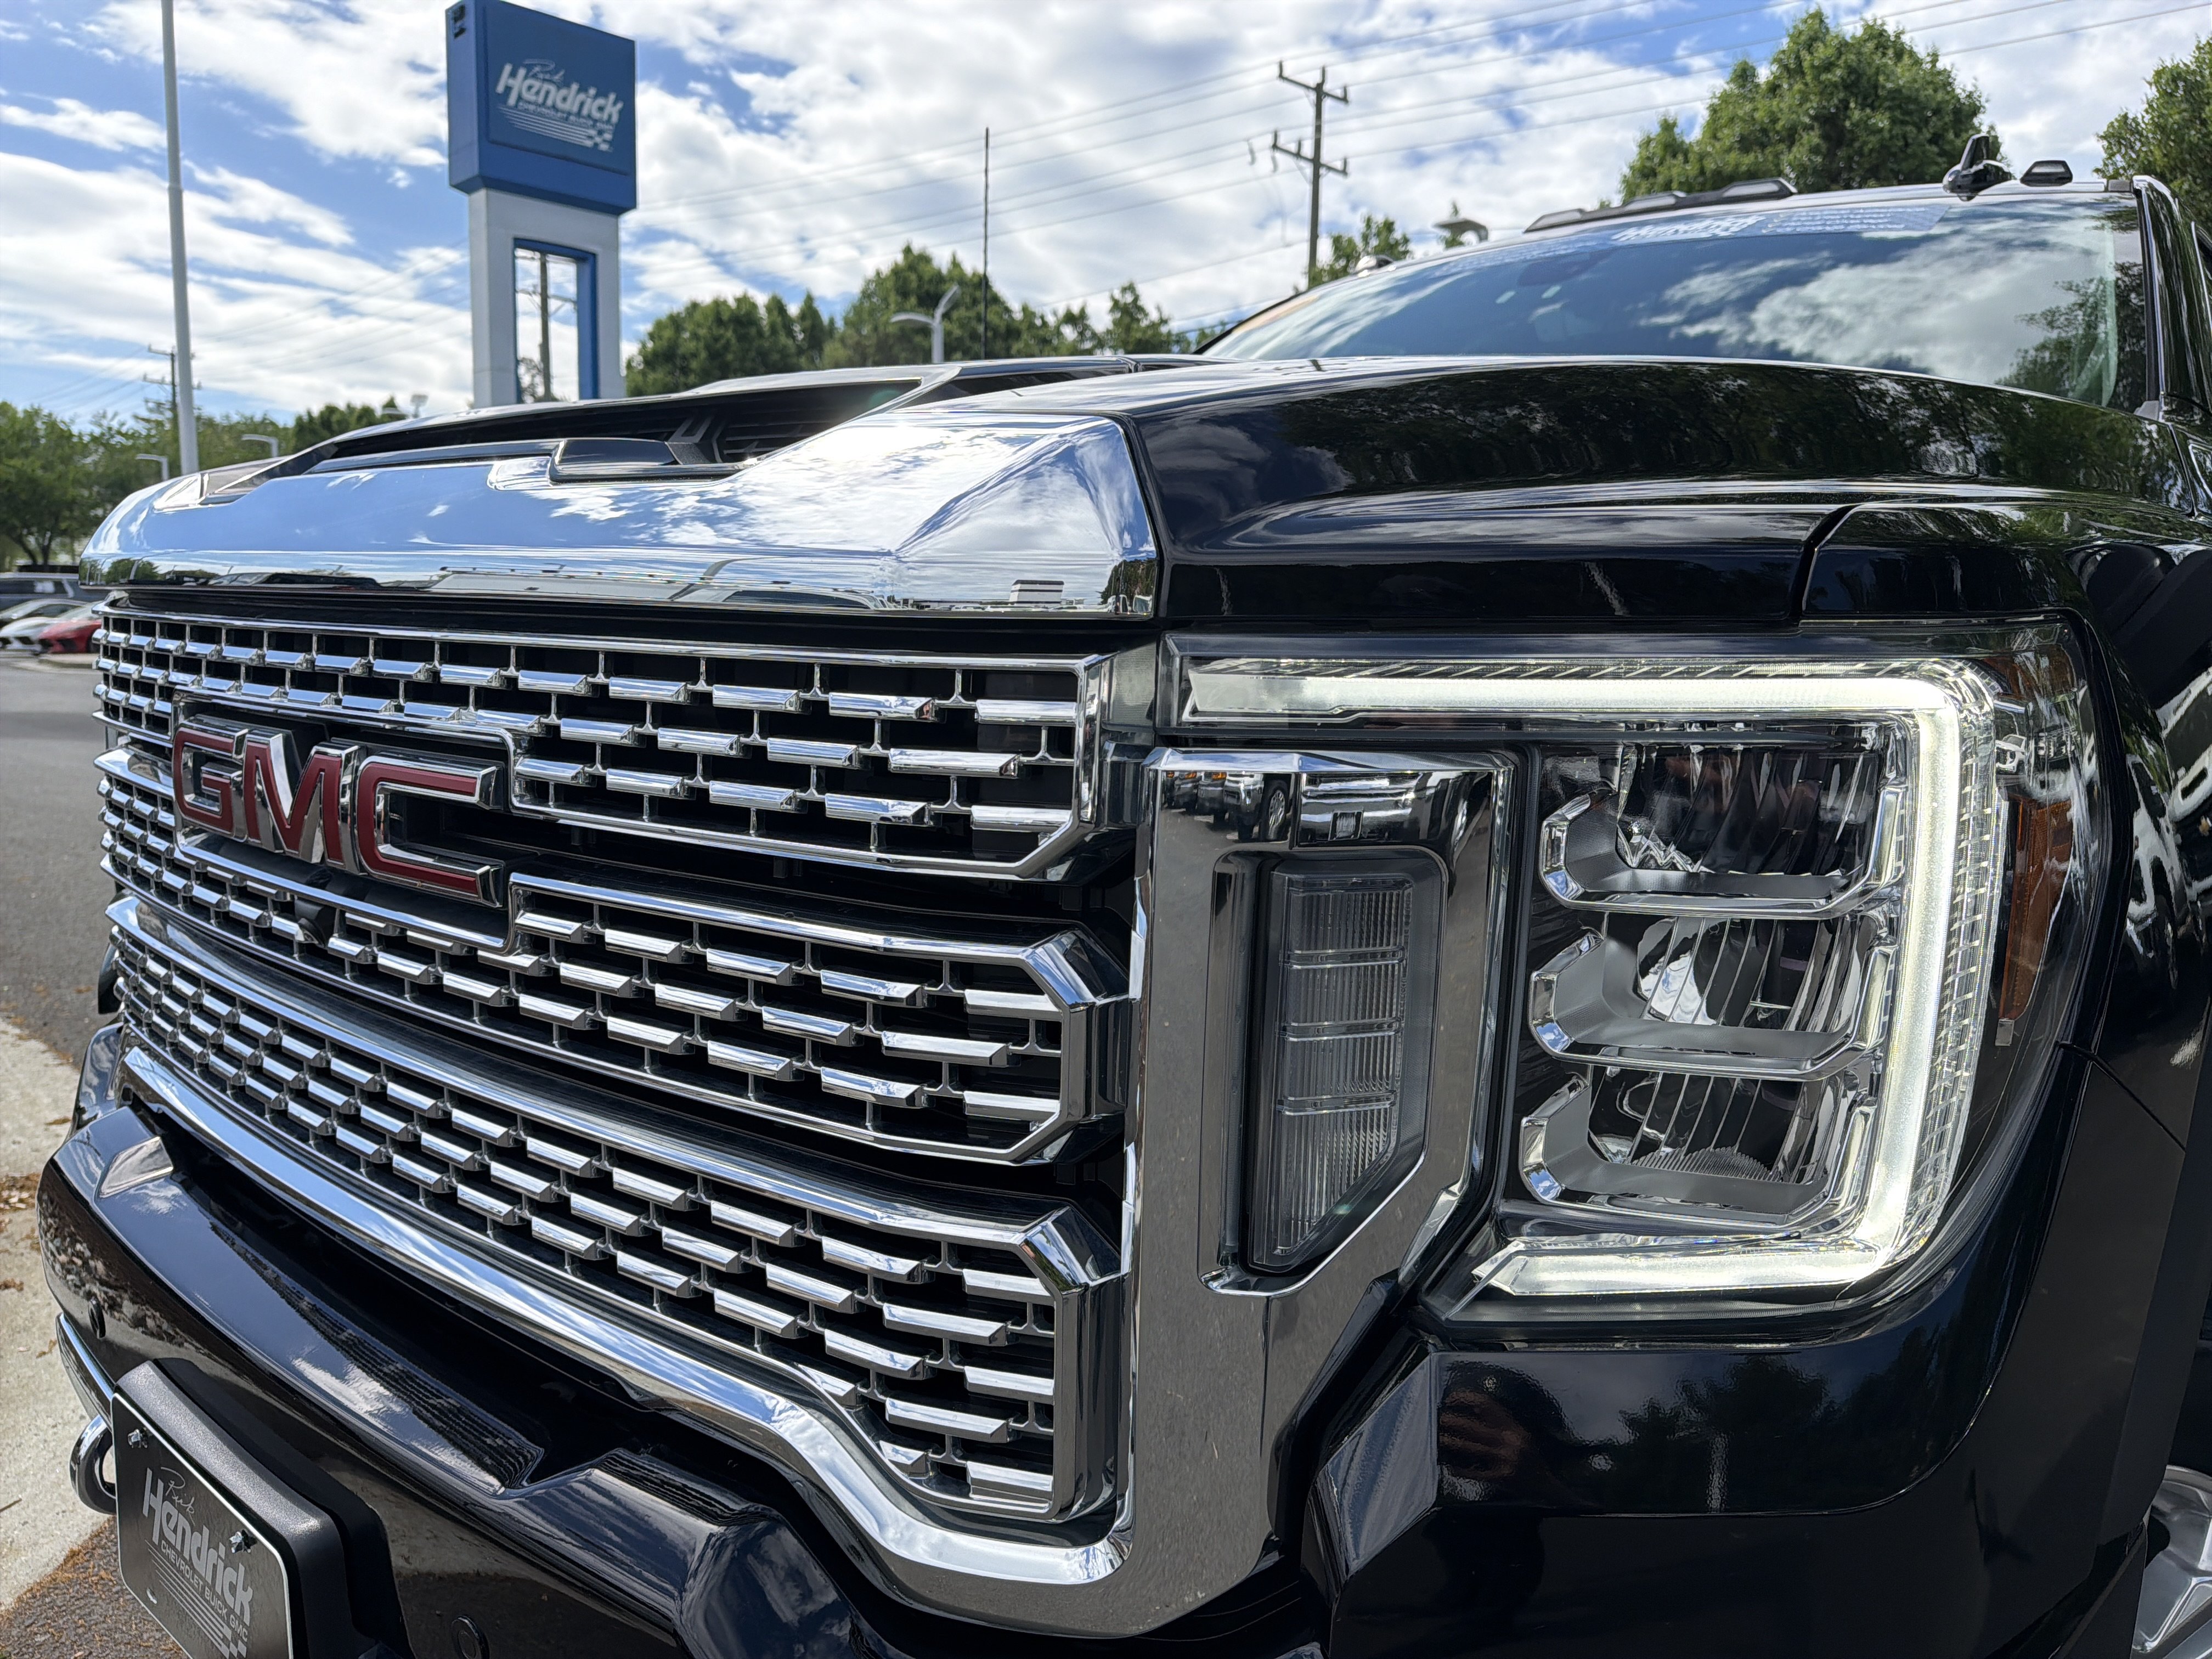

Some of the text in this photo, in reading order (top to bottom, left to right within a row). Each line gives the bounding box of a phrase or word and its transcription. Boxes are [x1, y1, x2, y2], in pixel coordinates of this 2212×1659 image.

[495, 63, 624, 124] Hendrick
[173, 716, 504, 908] GMC
[143, 1468, 253, 1627] Hendrick
[161, 1540, 247, 1642] CHEVROLET BUICK GMC
